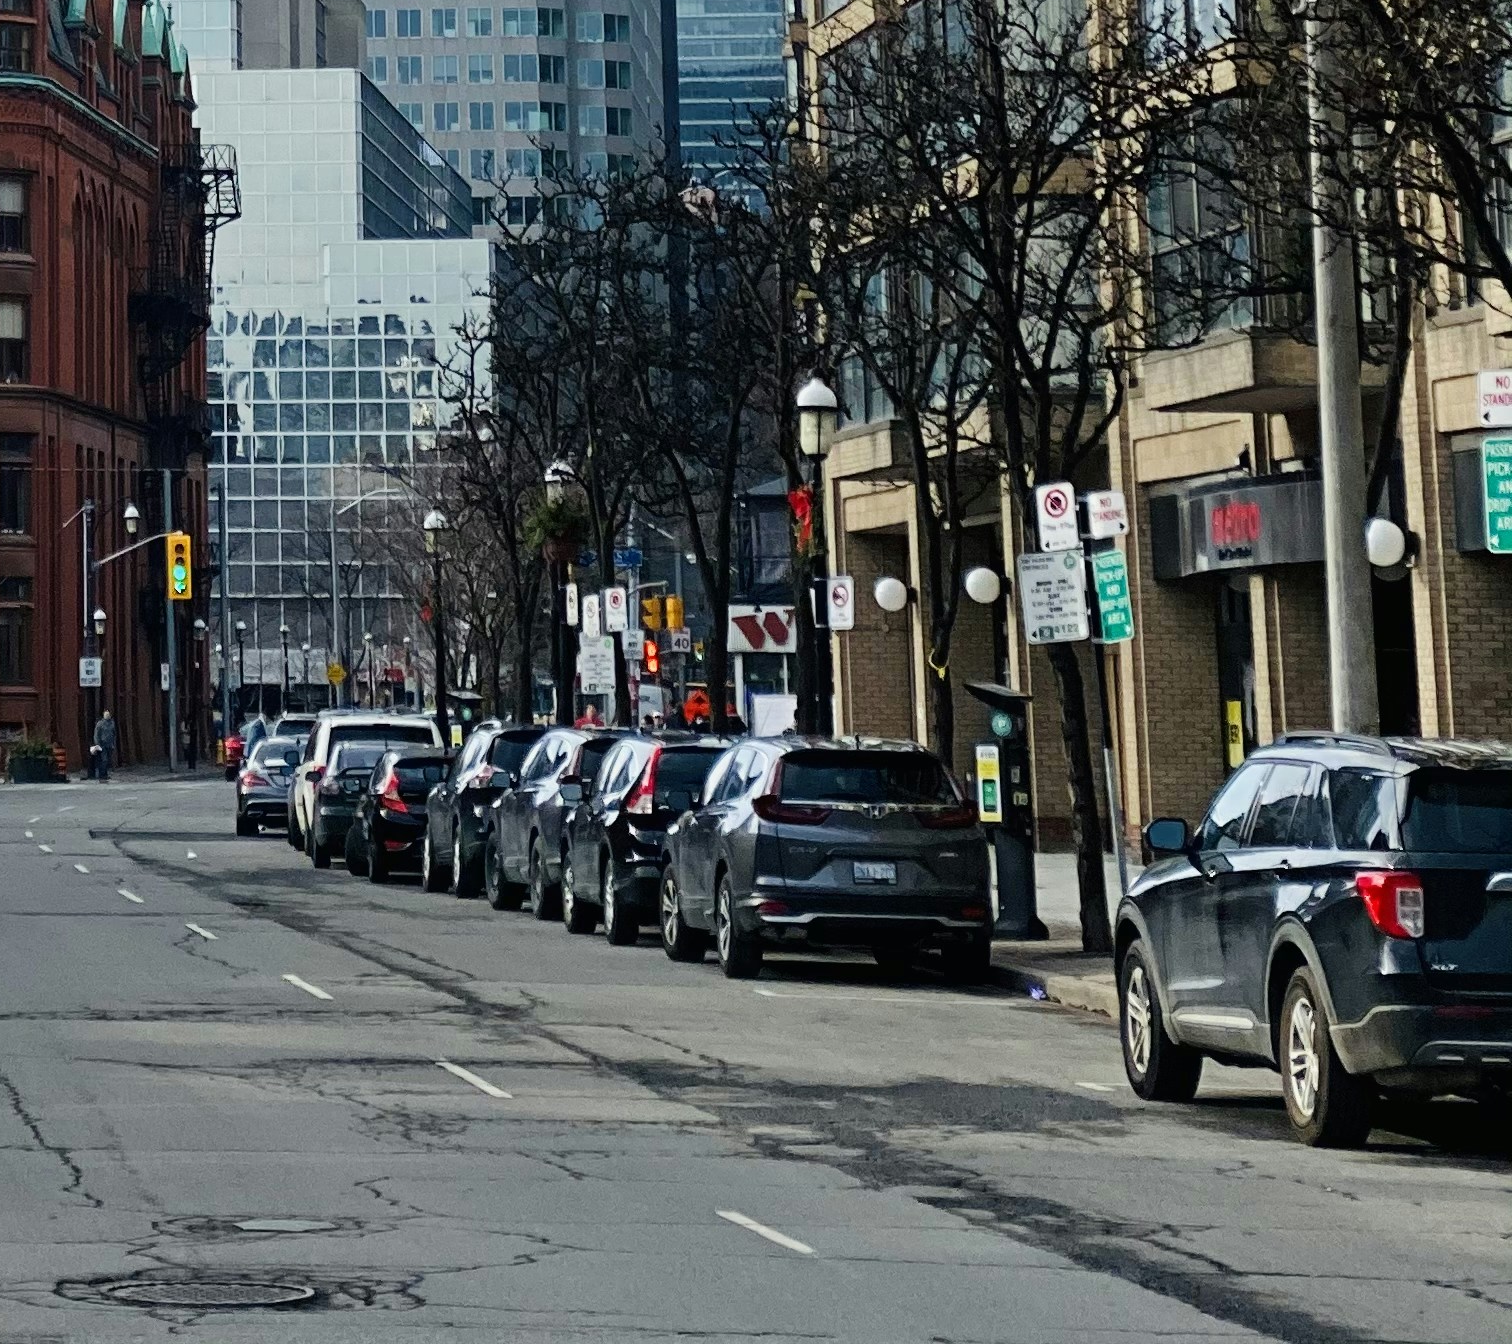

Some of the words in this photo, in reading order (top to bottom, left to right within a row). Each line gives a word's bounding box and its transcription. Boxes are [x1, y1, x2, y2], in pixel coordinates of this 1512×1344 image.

[1496, 375, 1510, 390] NO
[1488, 462, 1512, 476] PICK-
[1498, 480, 1512, 493] AN
[674, 637, 689, 649] 40
